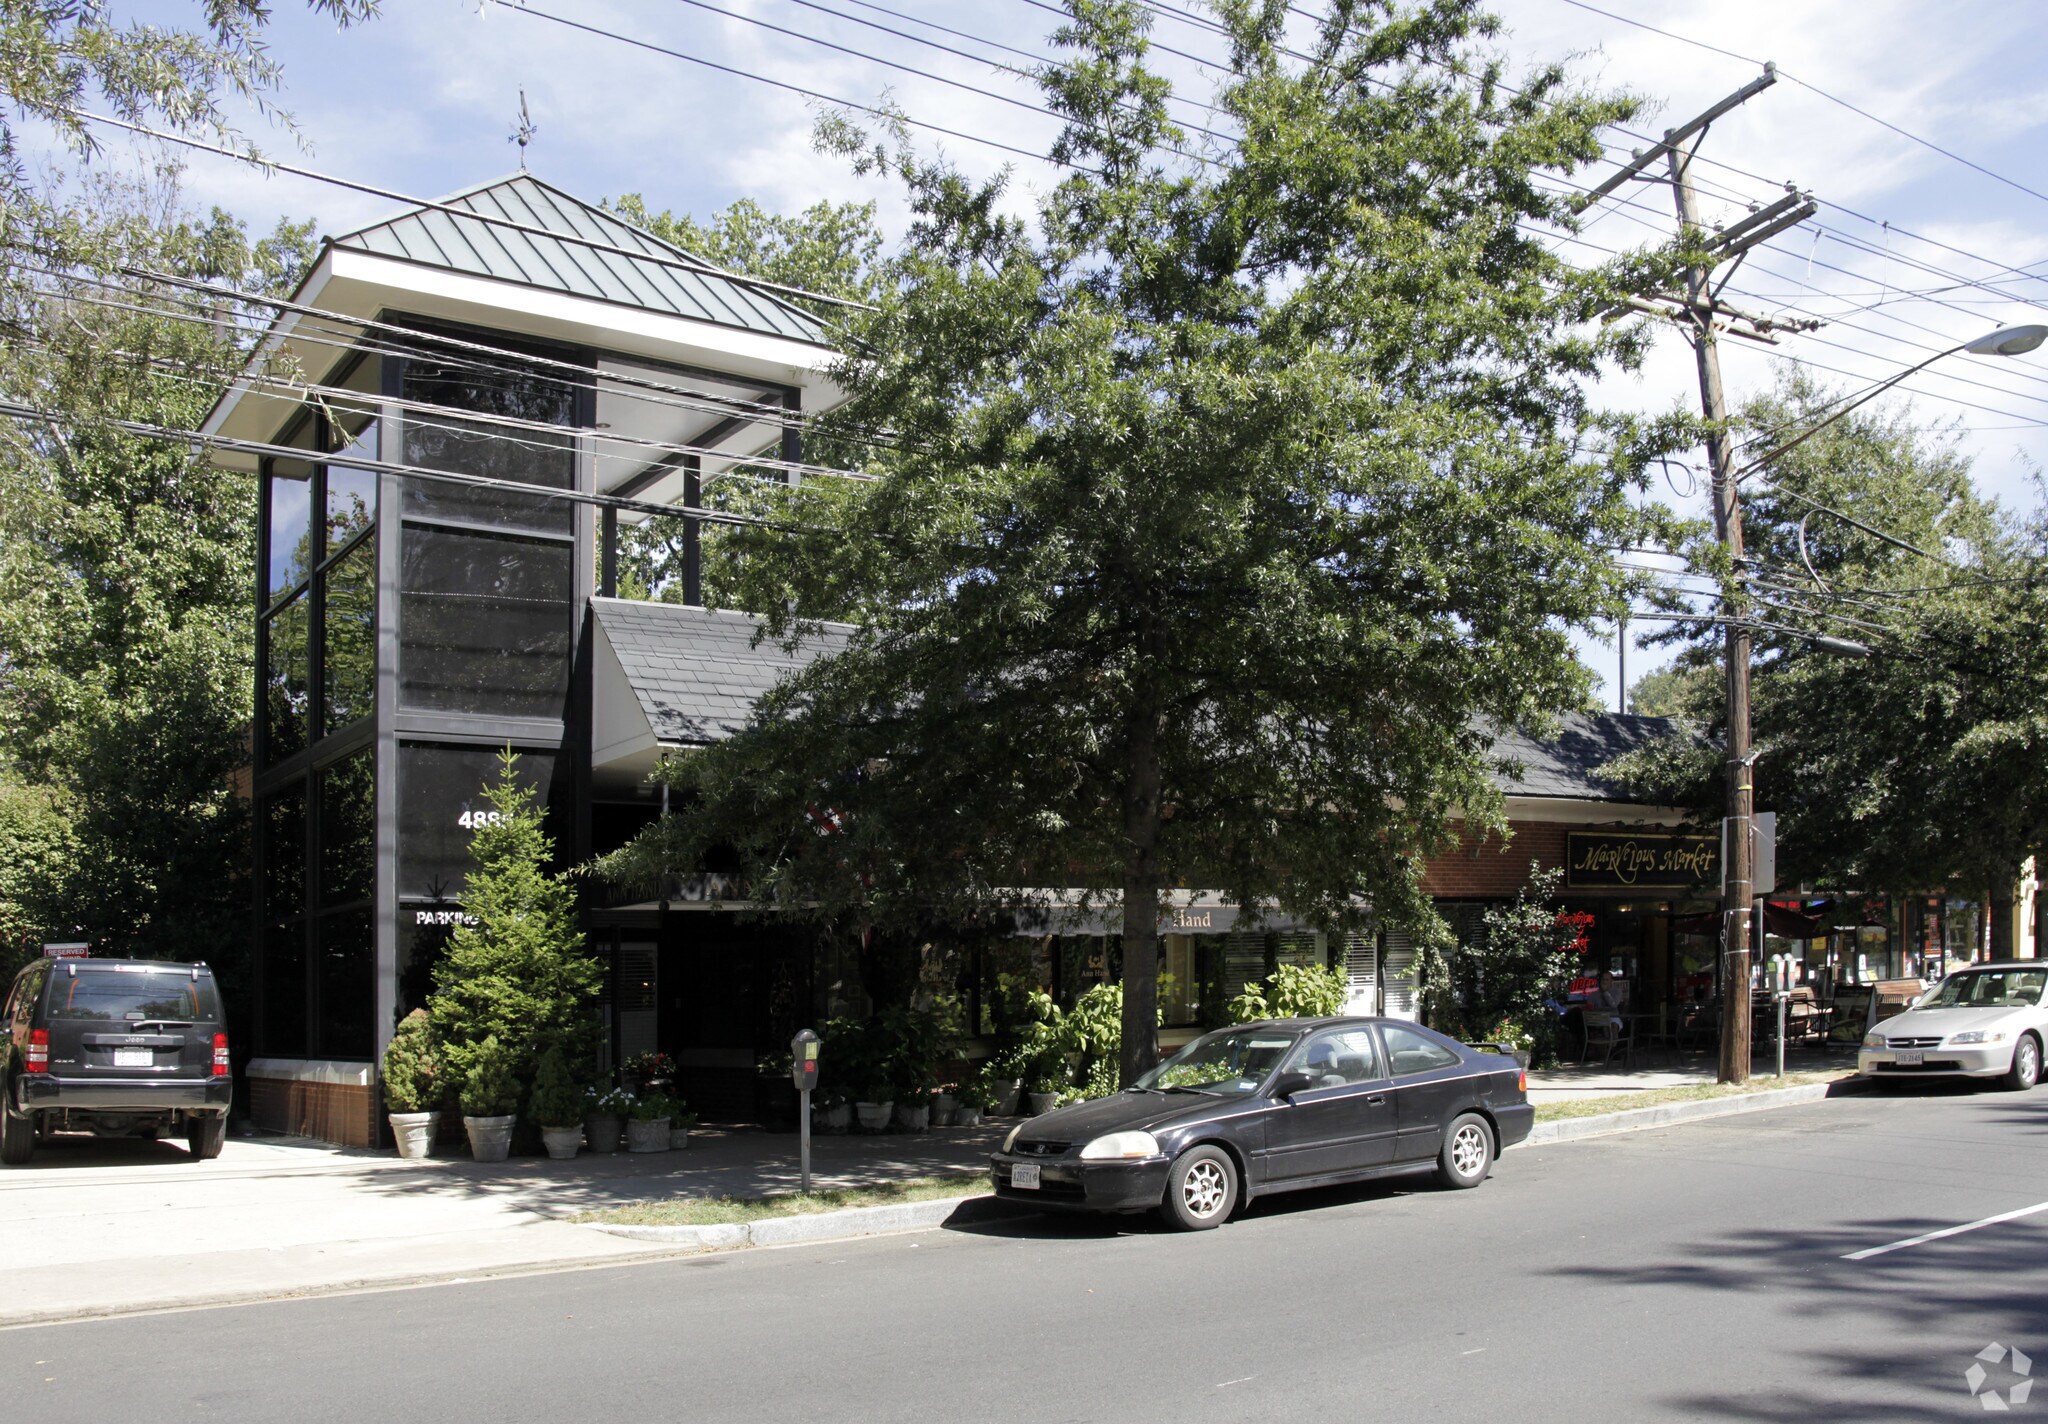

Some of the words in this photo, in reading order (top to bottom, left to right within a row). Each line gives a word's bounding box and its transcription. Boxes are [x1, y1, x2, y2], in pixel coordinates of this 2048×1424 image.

[1173, 909, 1212, 928] Hand
[47, 948, 85, 956] RESERVED
[124, 1036, 146, 1044] Jeep
